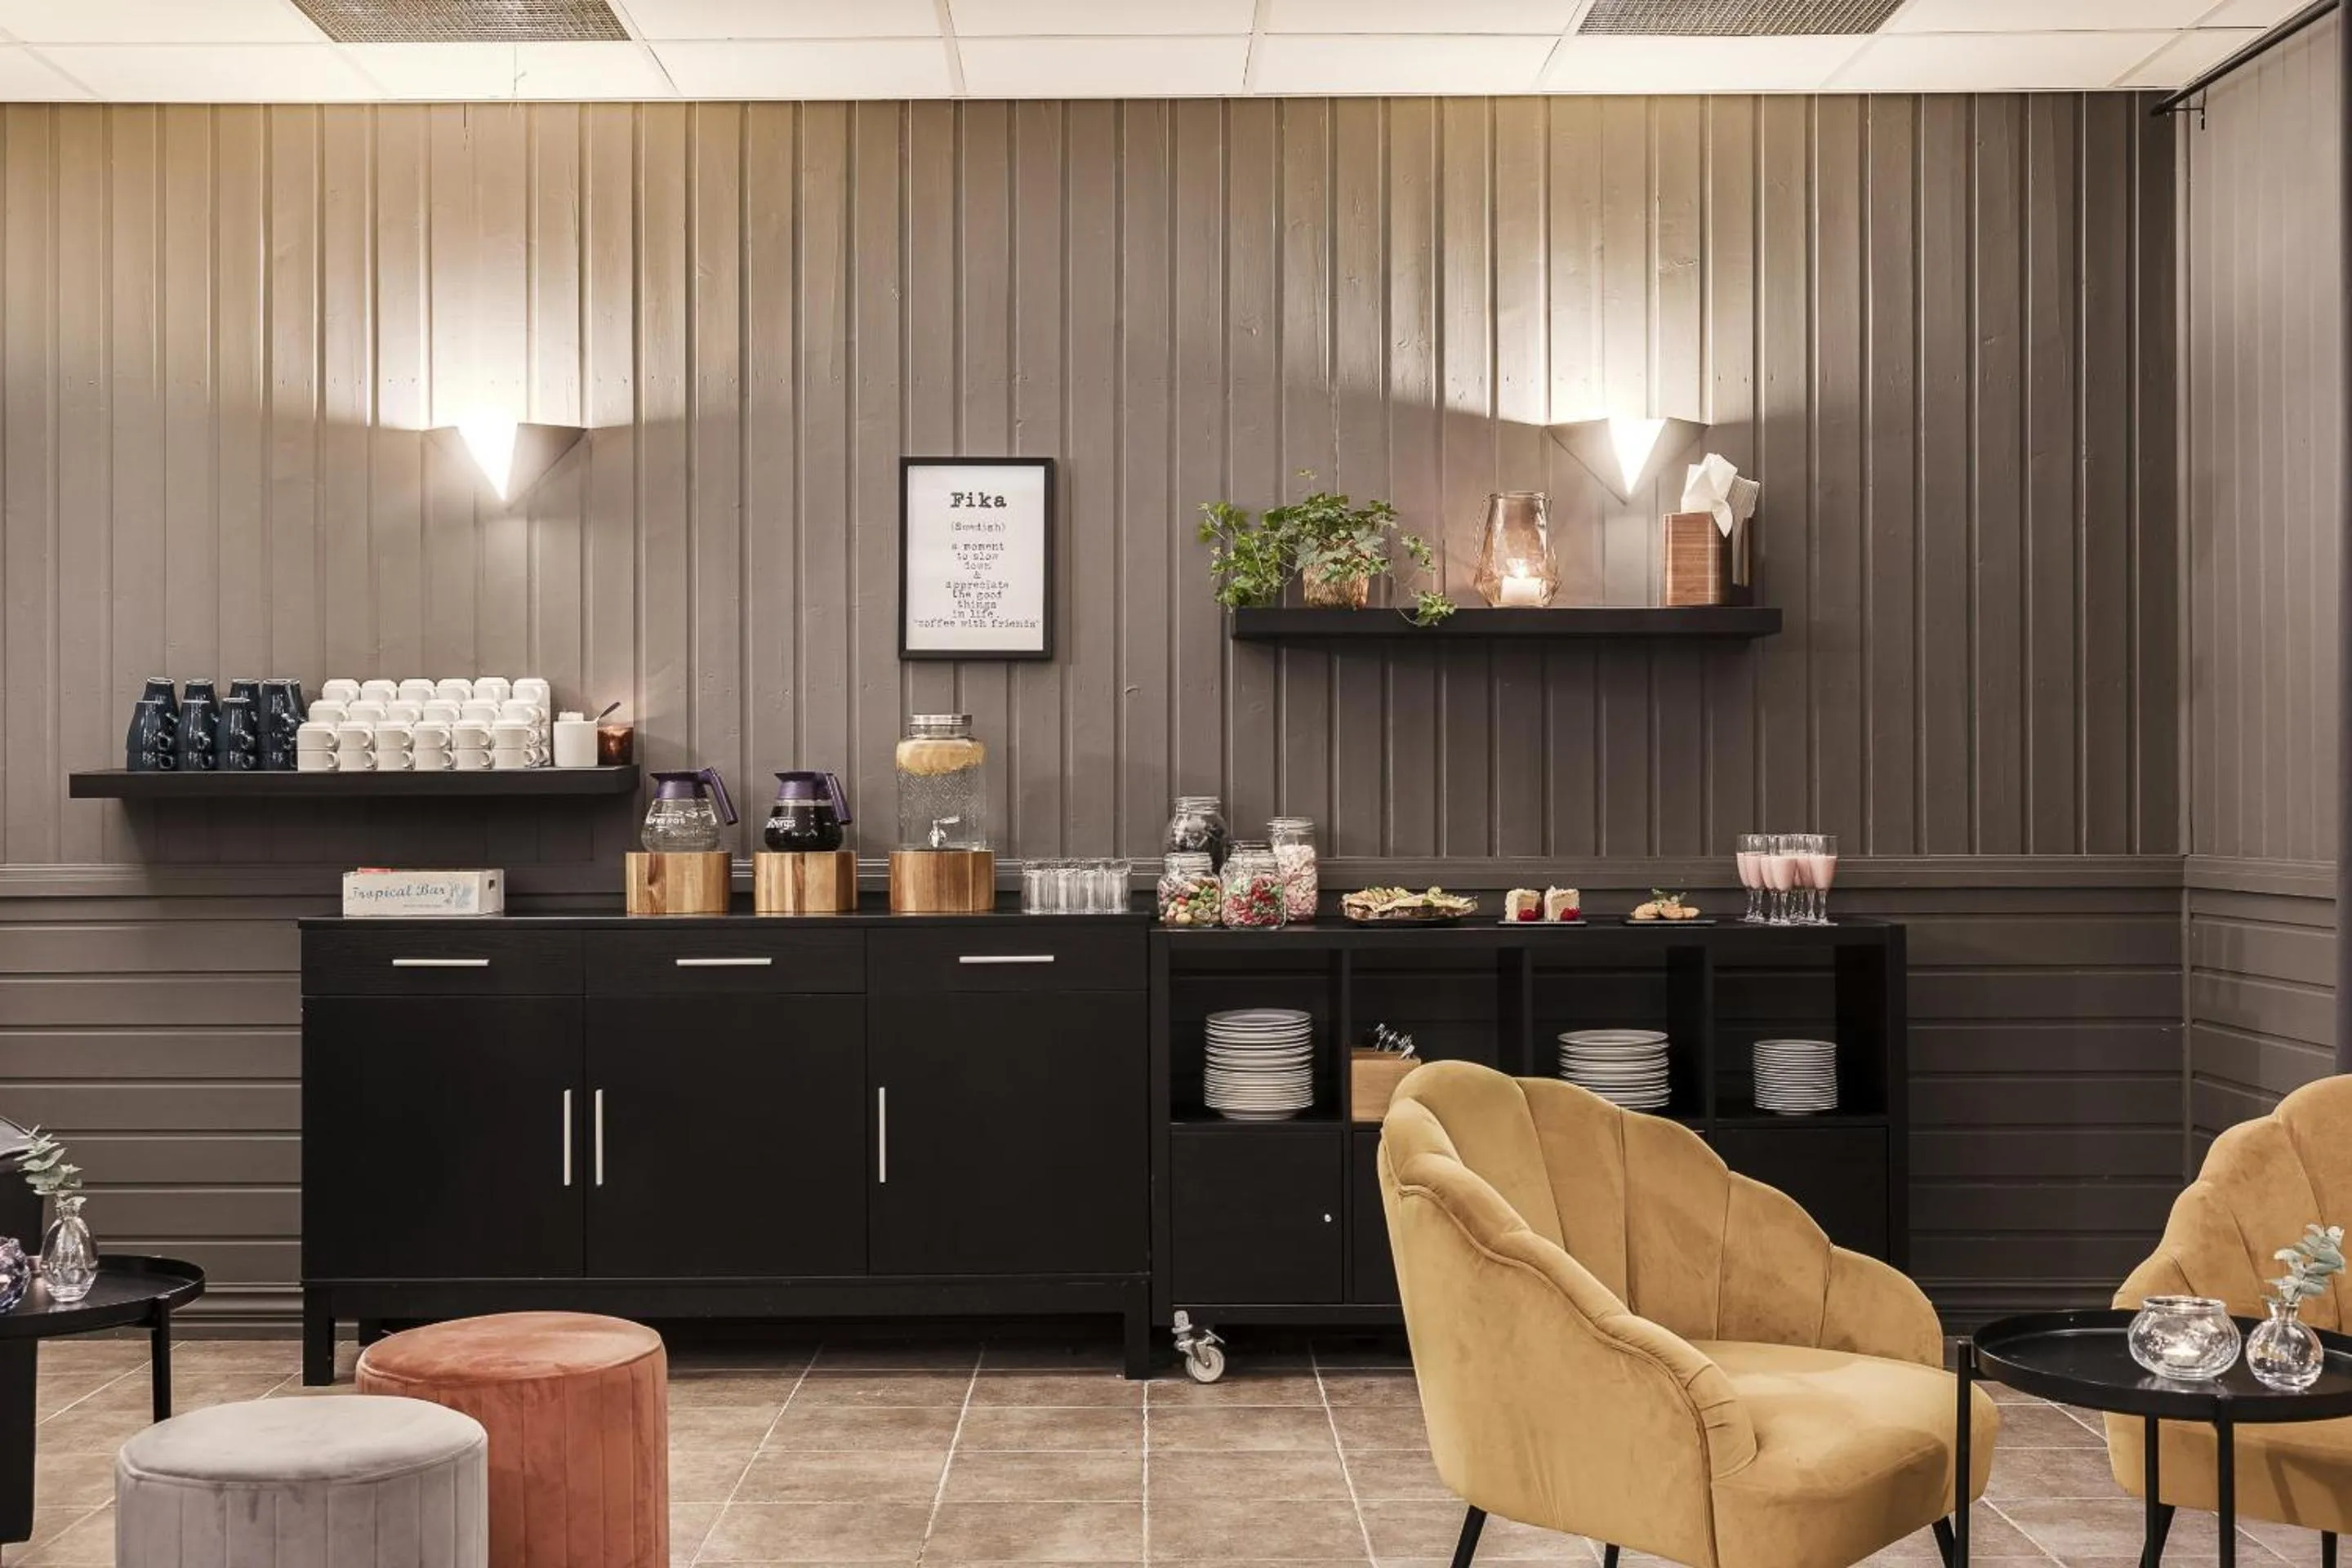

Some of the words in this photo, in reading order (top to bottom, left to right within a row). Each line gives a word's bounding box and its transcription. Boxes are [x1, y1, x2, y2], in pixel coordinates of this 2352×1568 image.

[951, 492, 1007, 508] Fika
[964, 542, 1004, 550] moment
[957, 552, 968, 560] to
[973, 552, 999, 560] slow
[964, 561, 991, 570] down
[946, 581, 1009, 590] appreciate
[977, 591, 1002, 600] good
[957, 600, 997, 610] things
[953, 610, 964, 618] in
[970, 609, 1000, 618] life.
[961, 619, 987, 628] with
[352, 885, 412, 902] Tropical
[416, 884, 445, 896] Bar
